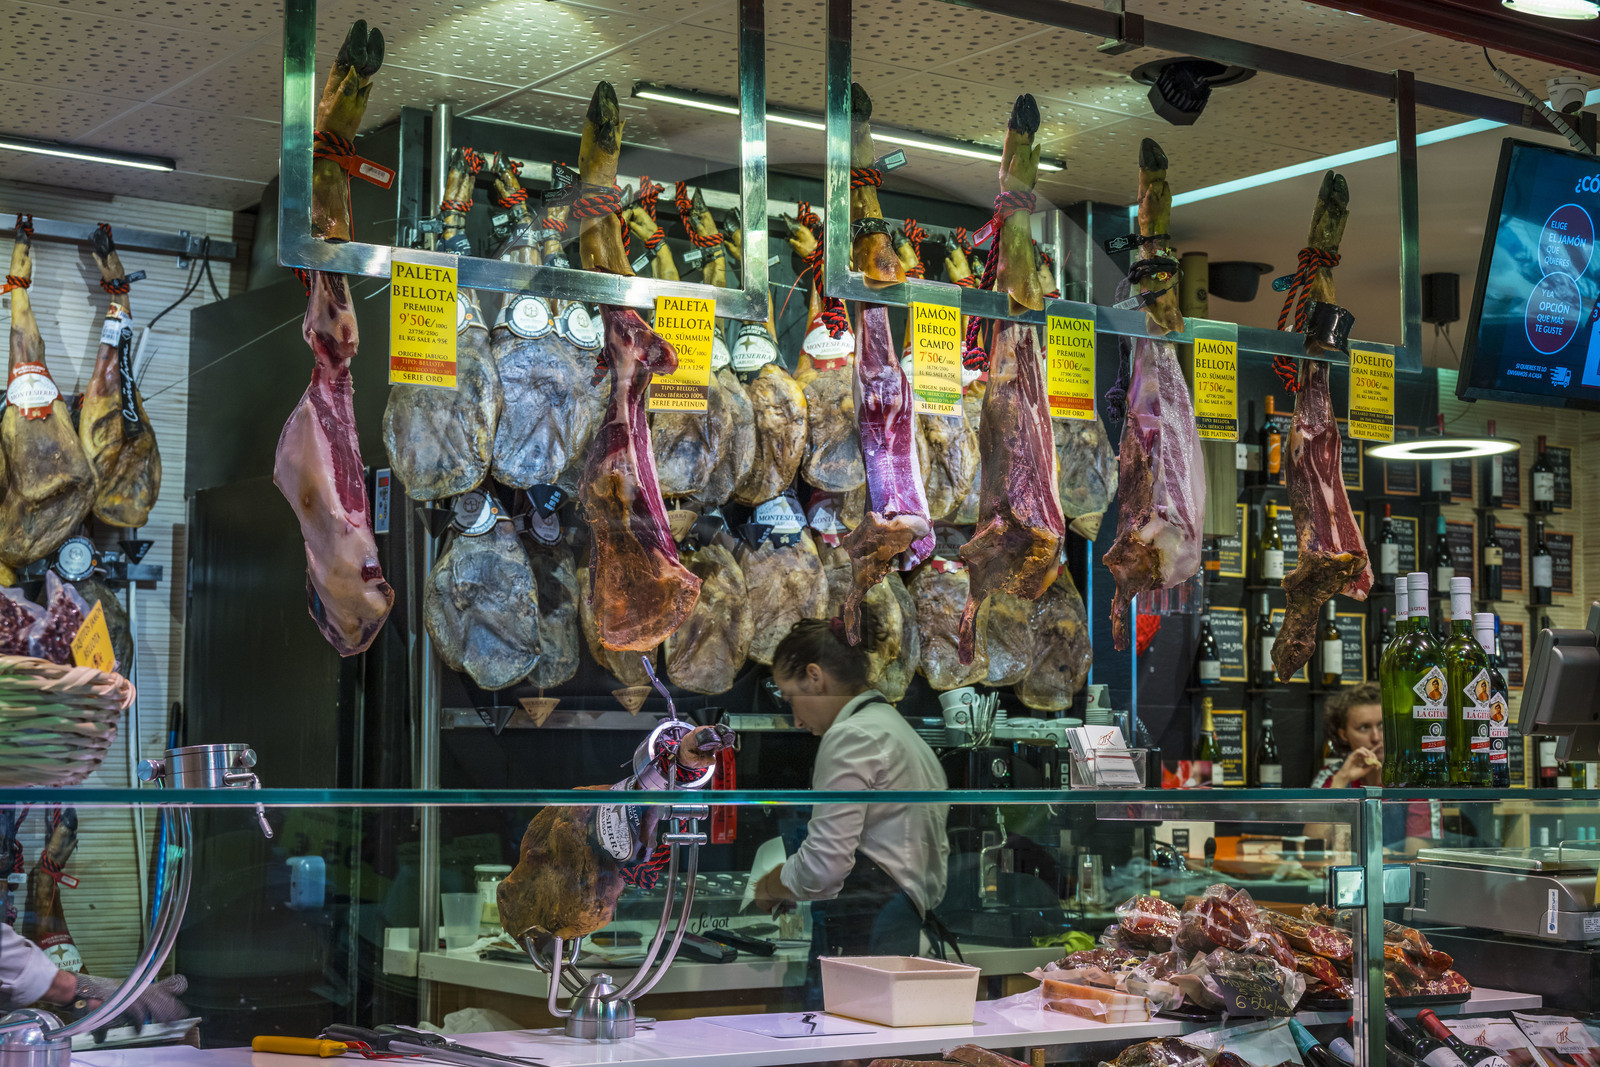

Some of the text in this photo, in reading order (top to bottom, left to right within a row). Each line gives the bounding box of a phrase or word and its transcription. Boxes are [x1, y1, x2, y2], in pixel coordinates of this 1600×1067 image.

[1574, 174, 1600, 194] ¿CÓ
[1550, 220, 1568, 230] ELIGE
[1548, 233, 1586, 248] EL JAMÓN
[1546, 246, 1560, 254] QUE
[1544, 256, 1570, 267] QUIERES
[396, 264, 452, 283] PALETA
[393, 285, 455, 302] BELLOTA
[404, 302, 444, 313] PREMIUM
[664, 299, 708, 312] PALETA
[1539, 302, 1570, 314] OPCIÓN
[916, 306, 956, 321] JAMÓN
[1537, 314, 1564, 324] QUE MÁS
[1593, 309, 1598, 318] 3
[658, 317, 712, 330] BELLOTA
[917, 323, 956, 336] IBÉRICO
[1051, 318, 1090, 331] JAMÓN
[1536, 324, 1563, 335] TE GUSTE
[676, 332, 710, 342] SÚMMUM
[1049, 335, 1093, 349] BELLOTA
[806, 341, 854, 351] MONTESIERRA
[920, 339, 954, 350] CAMPO
[1198, 342, 1233, 355] JAMÓN
[1057, 350, 1086, 358] PREMIUM
[1196, 358, 1236, 371] BELLOTA
[1353, 353, 1393, 368] JOSELITO
[1209, 372, 1235, 381] SÚMMUM
[1351, 367, 1394, 379] GRAN RESERVA
[10, 390, 57, 400] MONTESIERRA
[607, 806, 620, 858] ESIERRA
